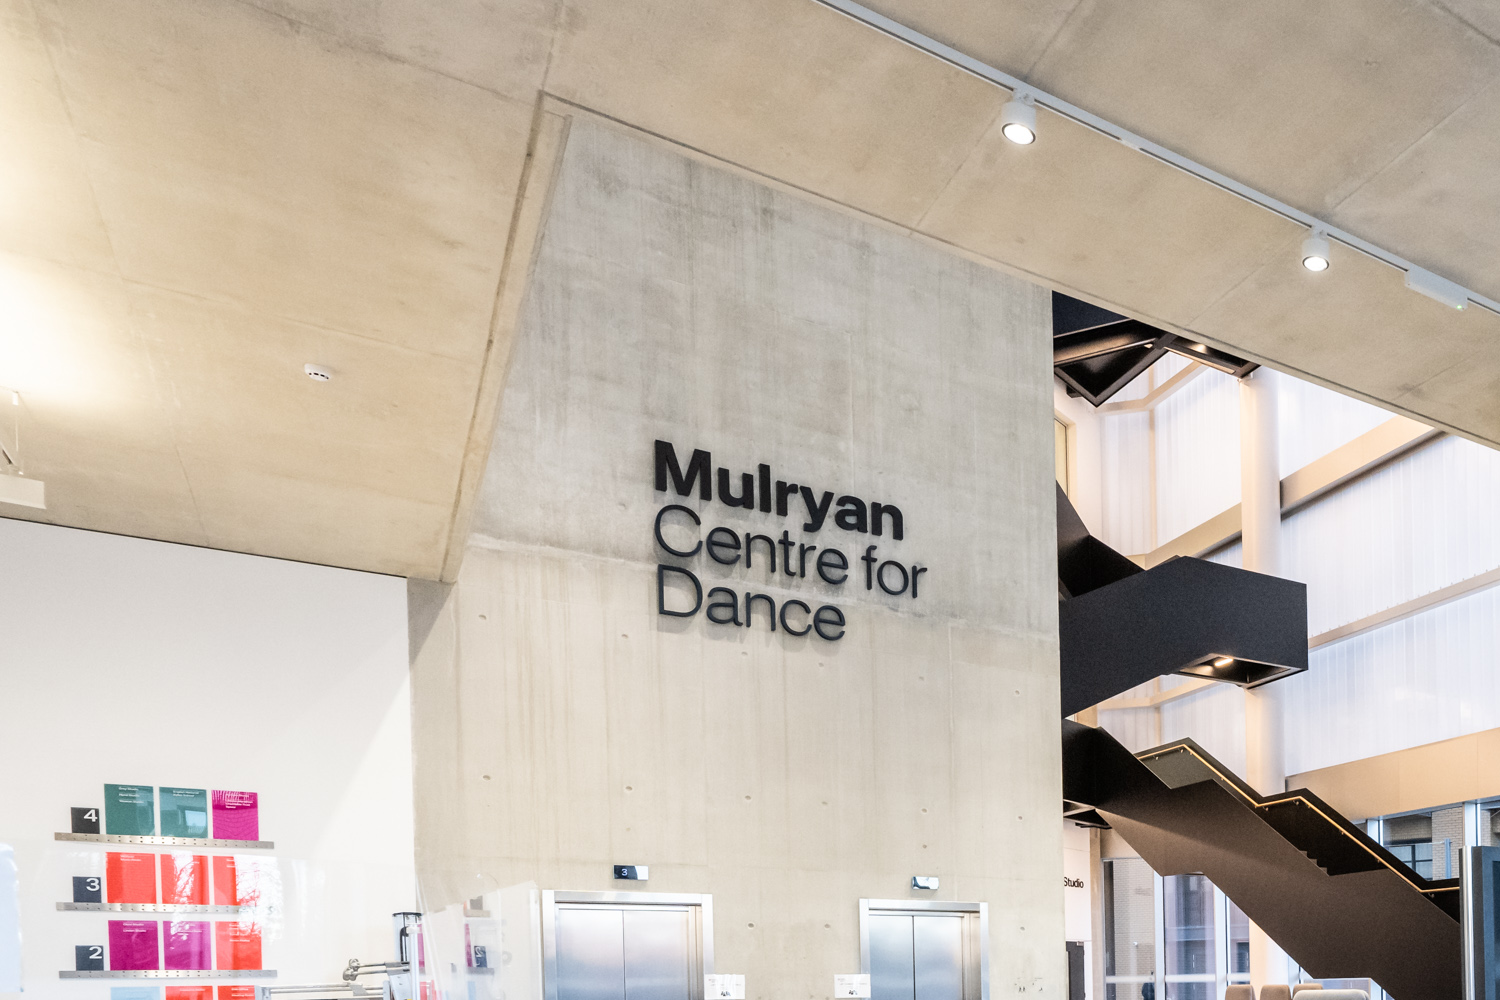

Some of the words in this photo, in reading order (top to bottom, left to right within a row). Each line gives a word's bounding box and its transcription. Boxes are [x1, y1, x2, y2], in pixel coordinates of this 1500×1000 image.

[654, 439, 904, 541] Mulryan
[654, 504, 849, 585] Centre
[861, 545, 928, 598] for
[658, 563, 845, 641] Dance
[83, 809, 98, 823] 4
[621, 868, 628, 876] 3
[86, 878, 100, 892] 3
[1064, 876, 1084, 888] Studio
[88, 946, 102, 960] 2
